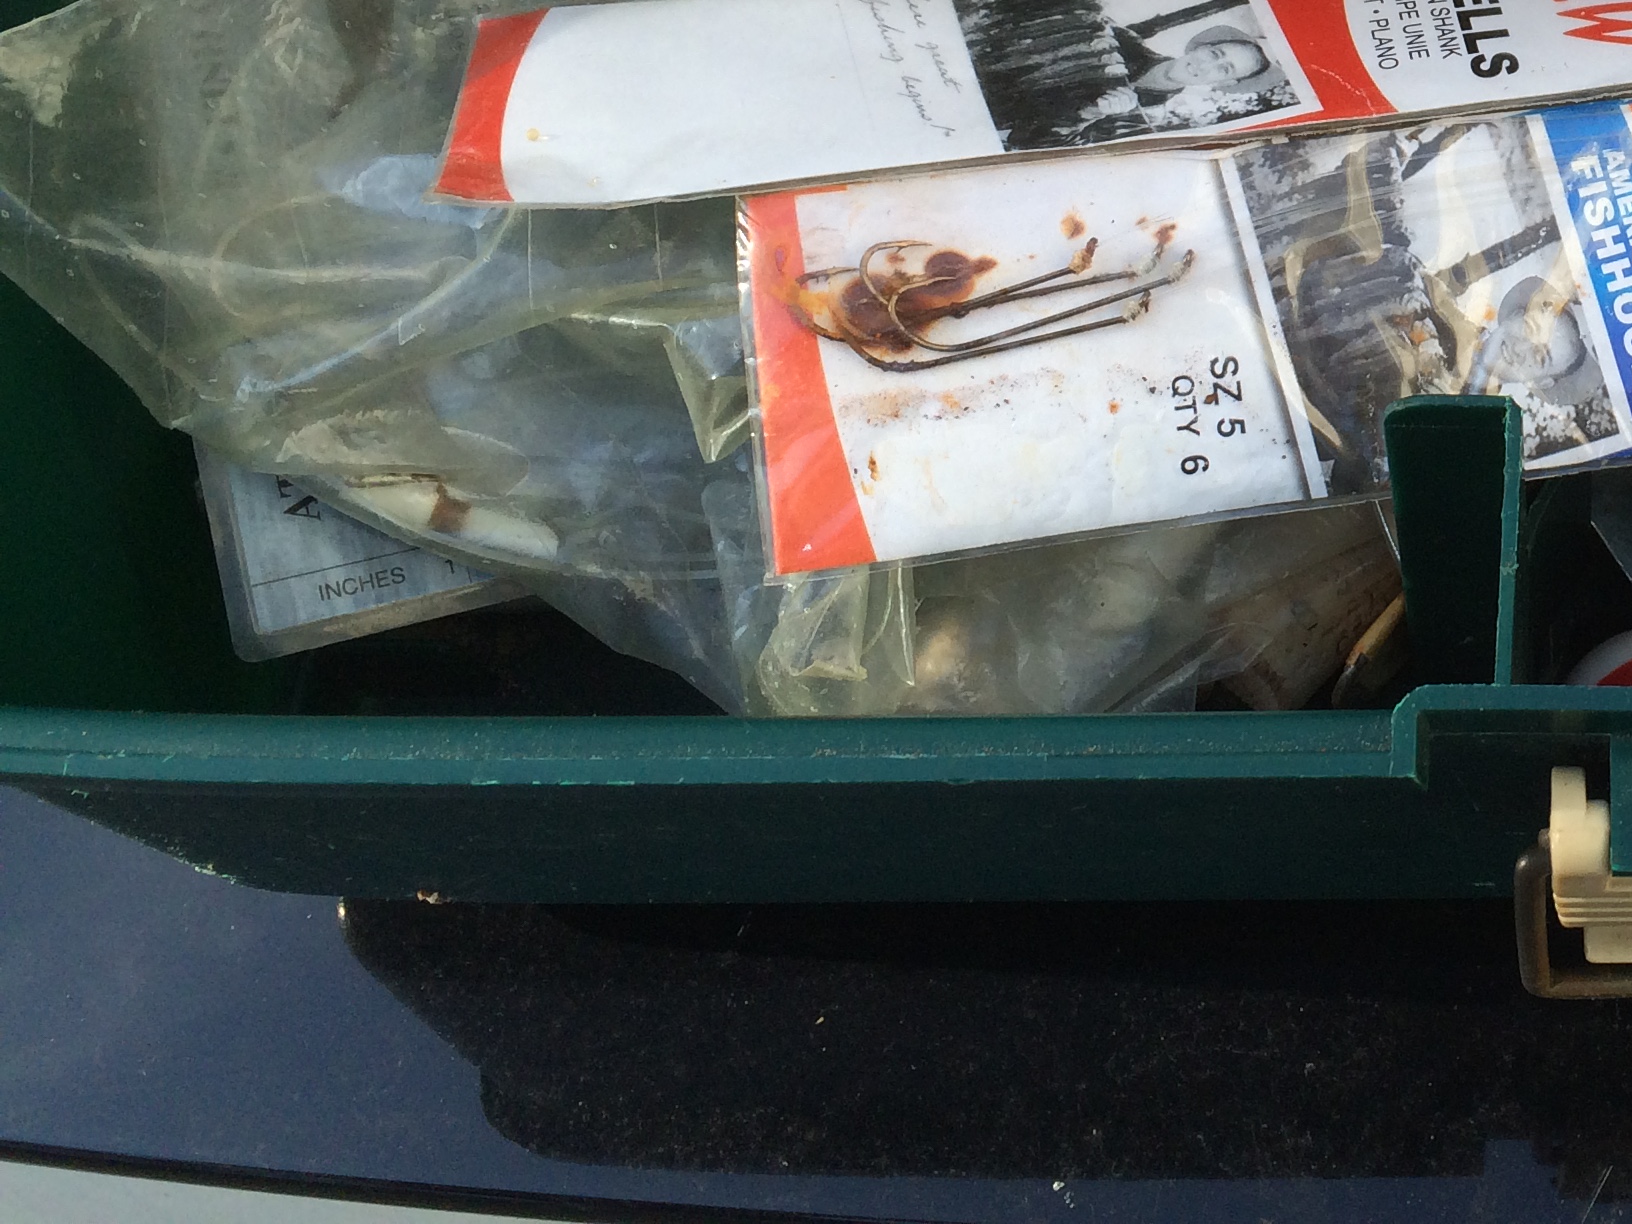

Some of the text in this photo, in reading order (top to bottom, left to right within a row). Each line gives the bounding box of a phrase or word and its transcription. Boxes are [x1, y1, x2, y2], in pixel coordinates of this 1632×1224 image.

[1368, 18, 1399, 70] PLANO
[1402, 23, 1431, 61] UNIE
[1430, 7, 1463, 60] SHANK
[1171, 374, 1210, 476] QTY 6
[1216, 417, 1247, 438] 5
[317, 565, 407, 603] INCHES
